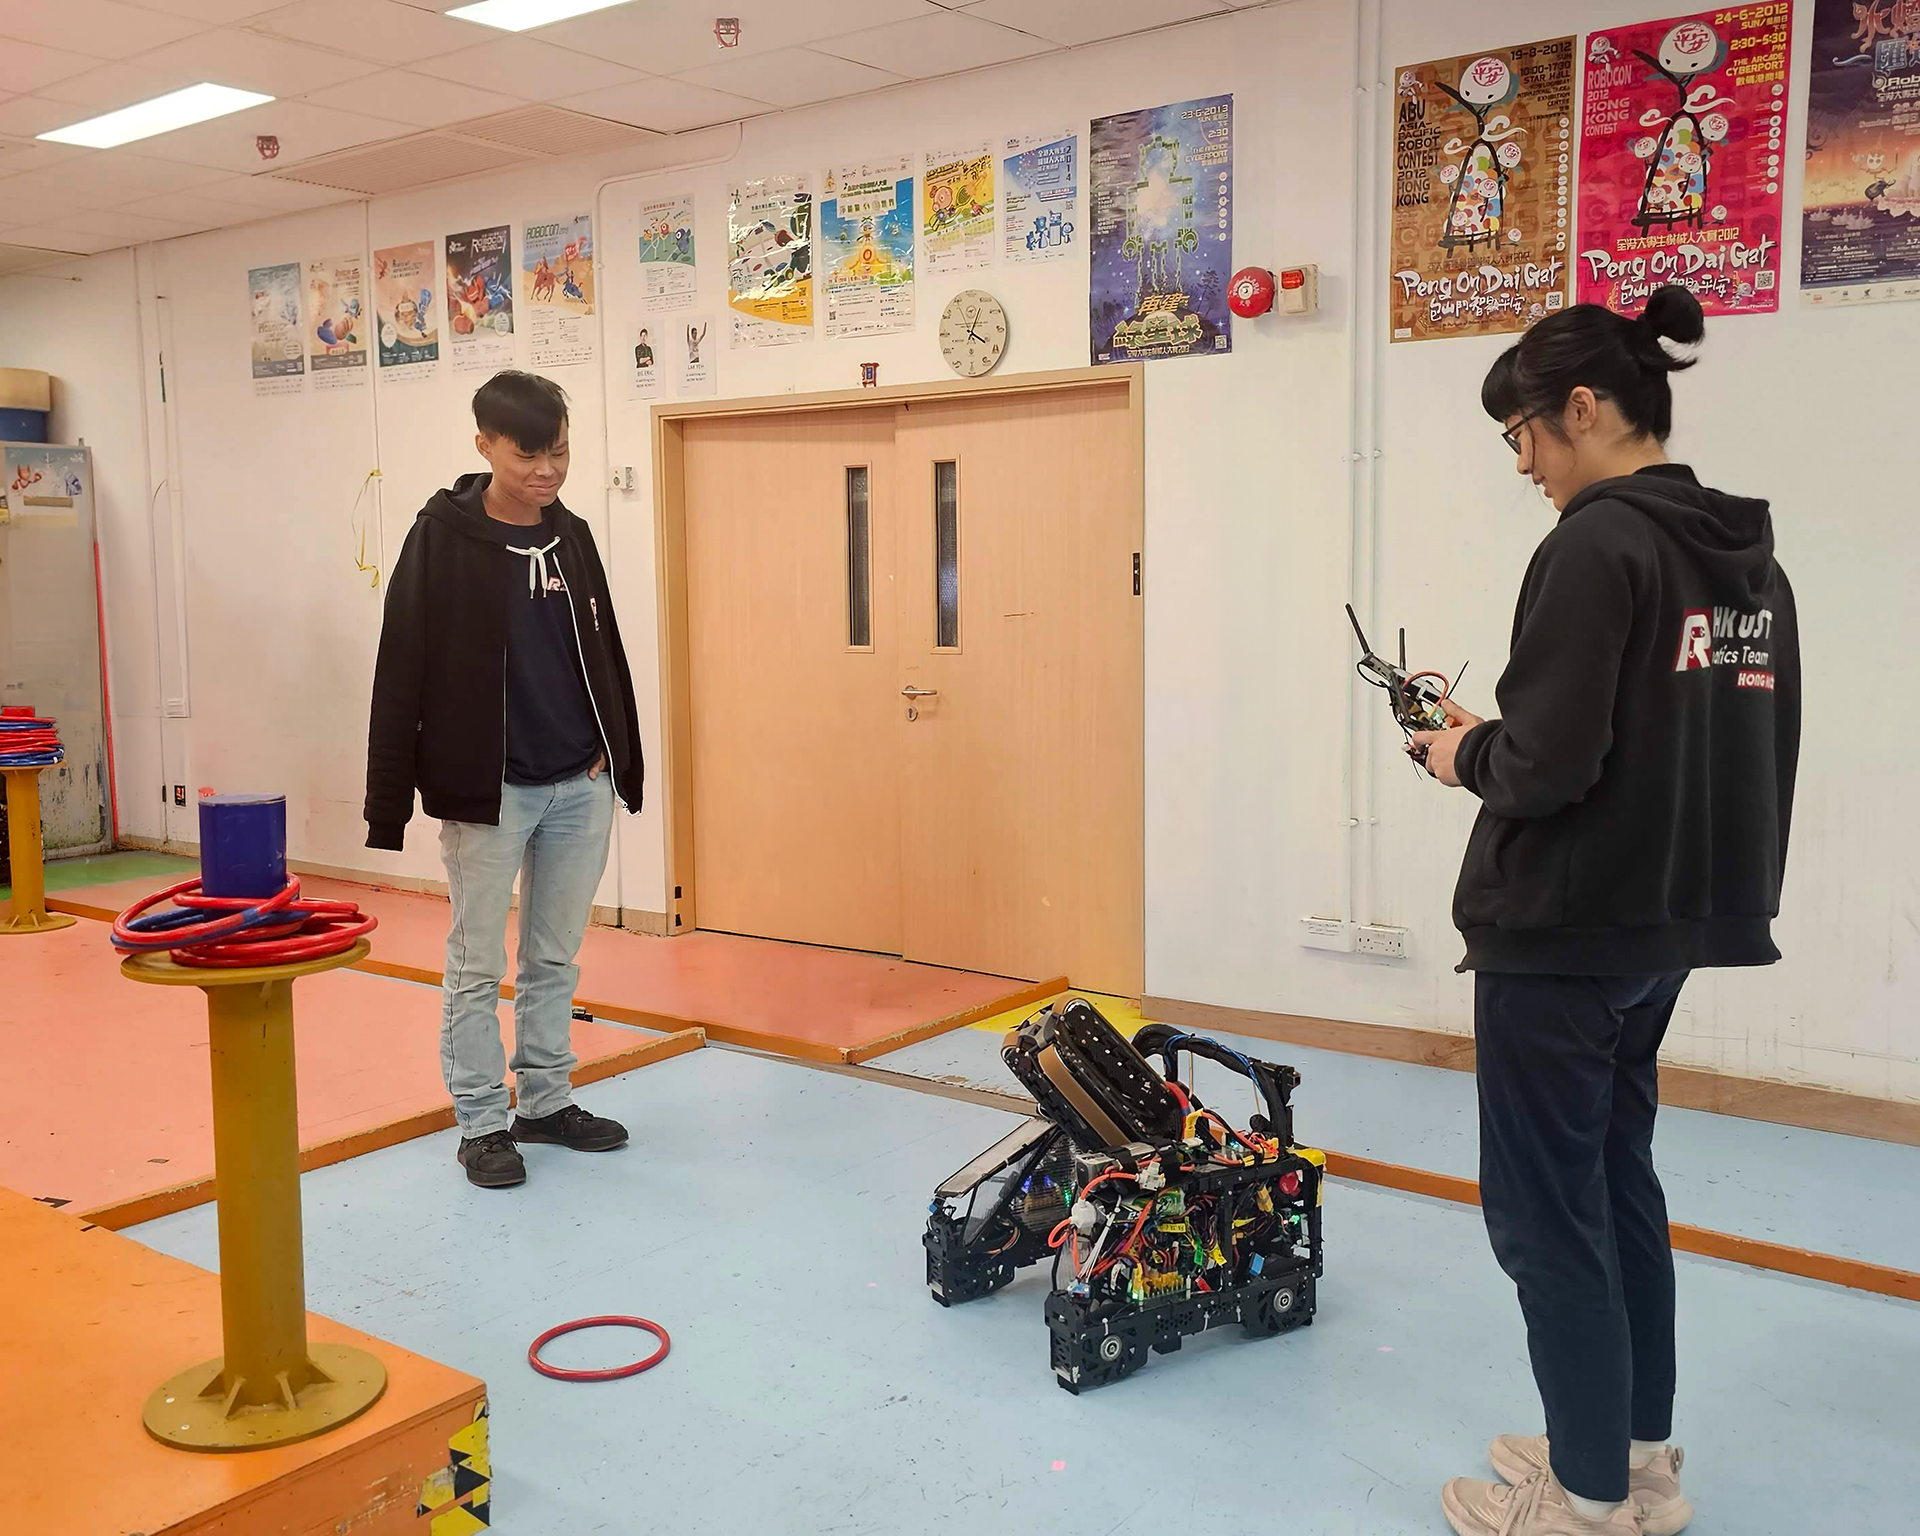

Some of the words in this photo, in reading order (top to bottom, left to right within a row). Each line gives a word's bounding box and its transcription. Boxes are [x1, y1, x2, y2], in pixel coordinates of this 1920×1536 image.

[1715, 3, 1788, 25] 24-6-2012
[1730, 31, 1787, 51] 2:30-5:30
[1772, 43, 1786, 51] PM
[1511, 42, 1572, 60] 19-8-2012
[1734, 58, 1748, 66] THE
[1751, 52, 1785, 64] ARCADE
[1726, 60, 1785, 77] CYBERPORT
[1524, 74, 1546, 84] STAR
[1550, 70, 1571, 81] HALL
[1588, 65, 1632, 89] ROBOCON
[1587, 89, 1609, 102] 2012
[1399, 99, 1425, 123] ABU
[1586, 97, 1630, 113] HONG
[1585, 109, 1629, 125] KONG
[1208, 128, 1229, 138] 2:30
[1398, 126, 1441, 140] PACIFIC
[1399, 121, 1432, 132] ASIA-
[1585, 122, 1618, 137] CONTEST
[1398, 136, 1440, 152] ROBOT
[1397, 148, 1440, 170] CONTEST
[1397, 168, 1427, 181] 2012
[1397, 179, 1430, 194] HONG
[1396, 191, 1429, 207] KONG
[1580, 249, 1646, 281] Peng
[1651, 250, 1678, 274] On
[1676, 244, 1726, 276] Dai
[1730, 234, 1776, 269] Gat
[1394, 270, 1452, 300] Peng
[1456, 271, 1481, 293] On
[1479, 264, 1520, 295] Dai
[1523, 255, 1565, 288] Gat
[1742, 645, 1769, 665] Team
[1737, 672, 1766, 687] HONG
